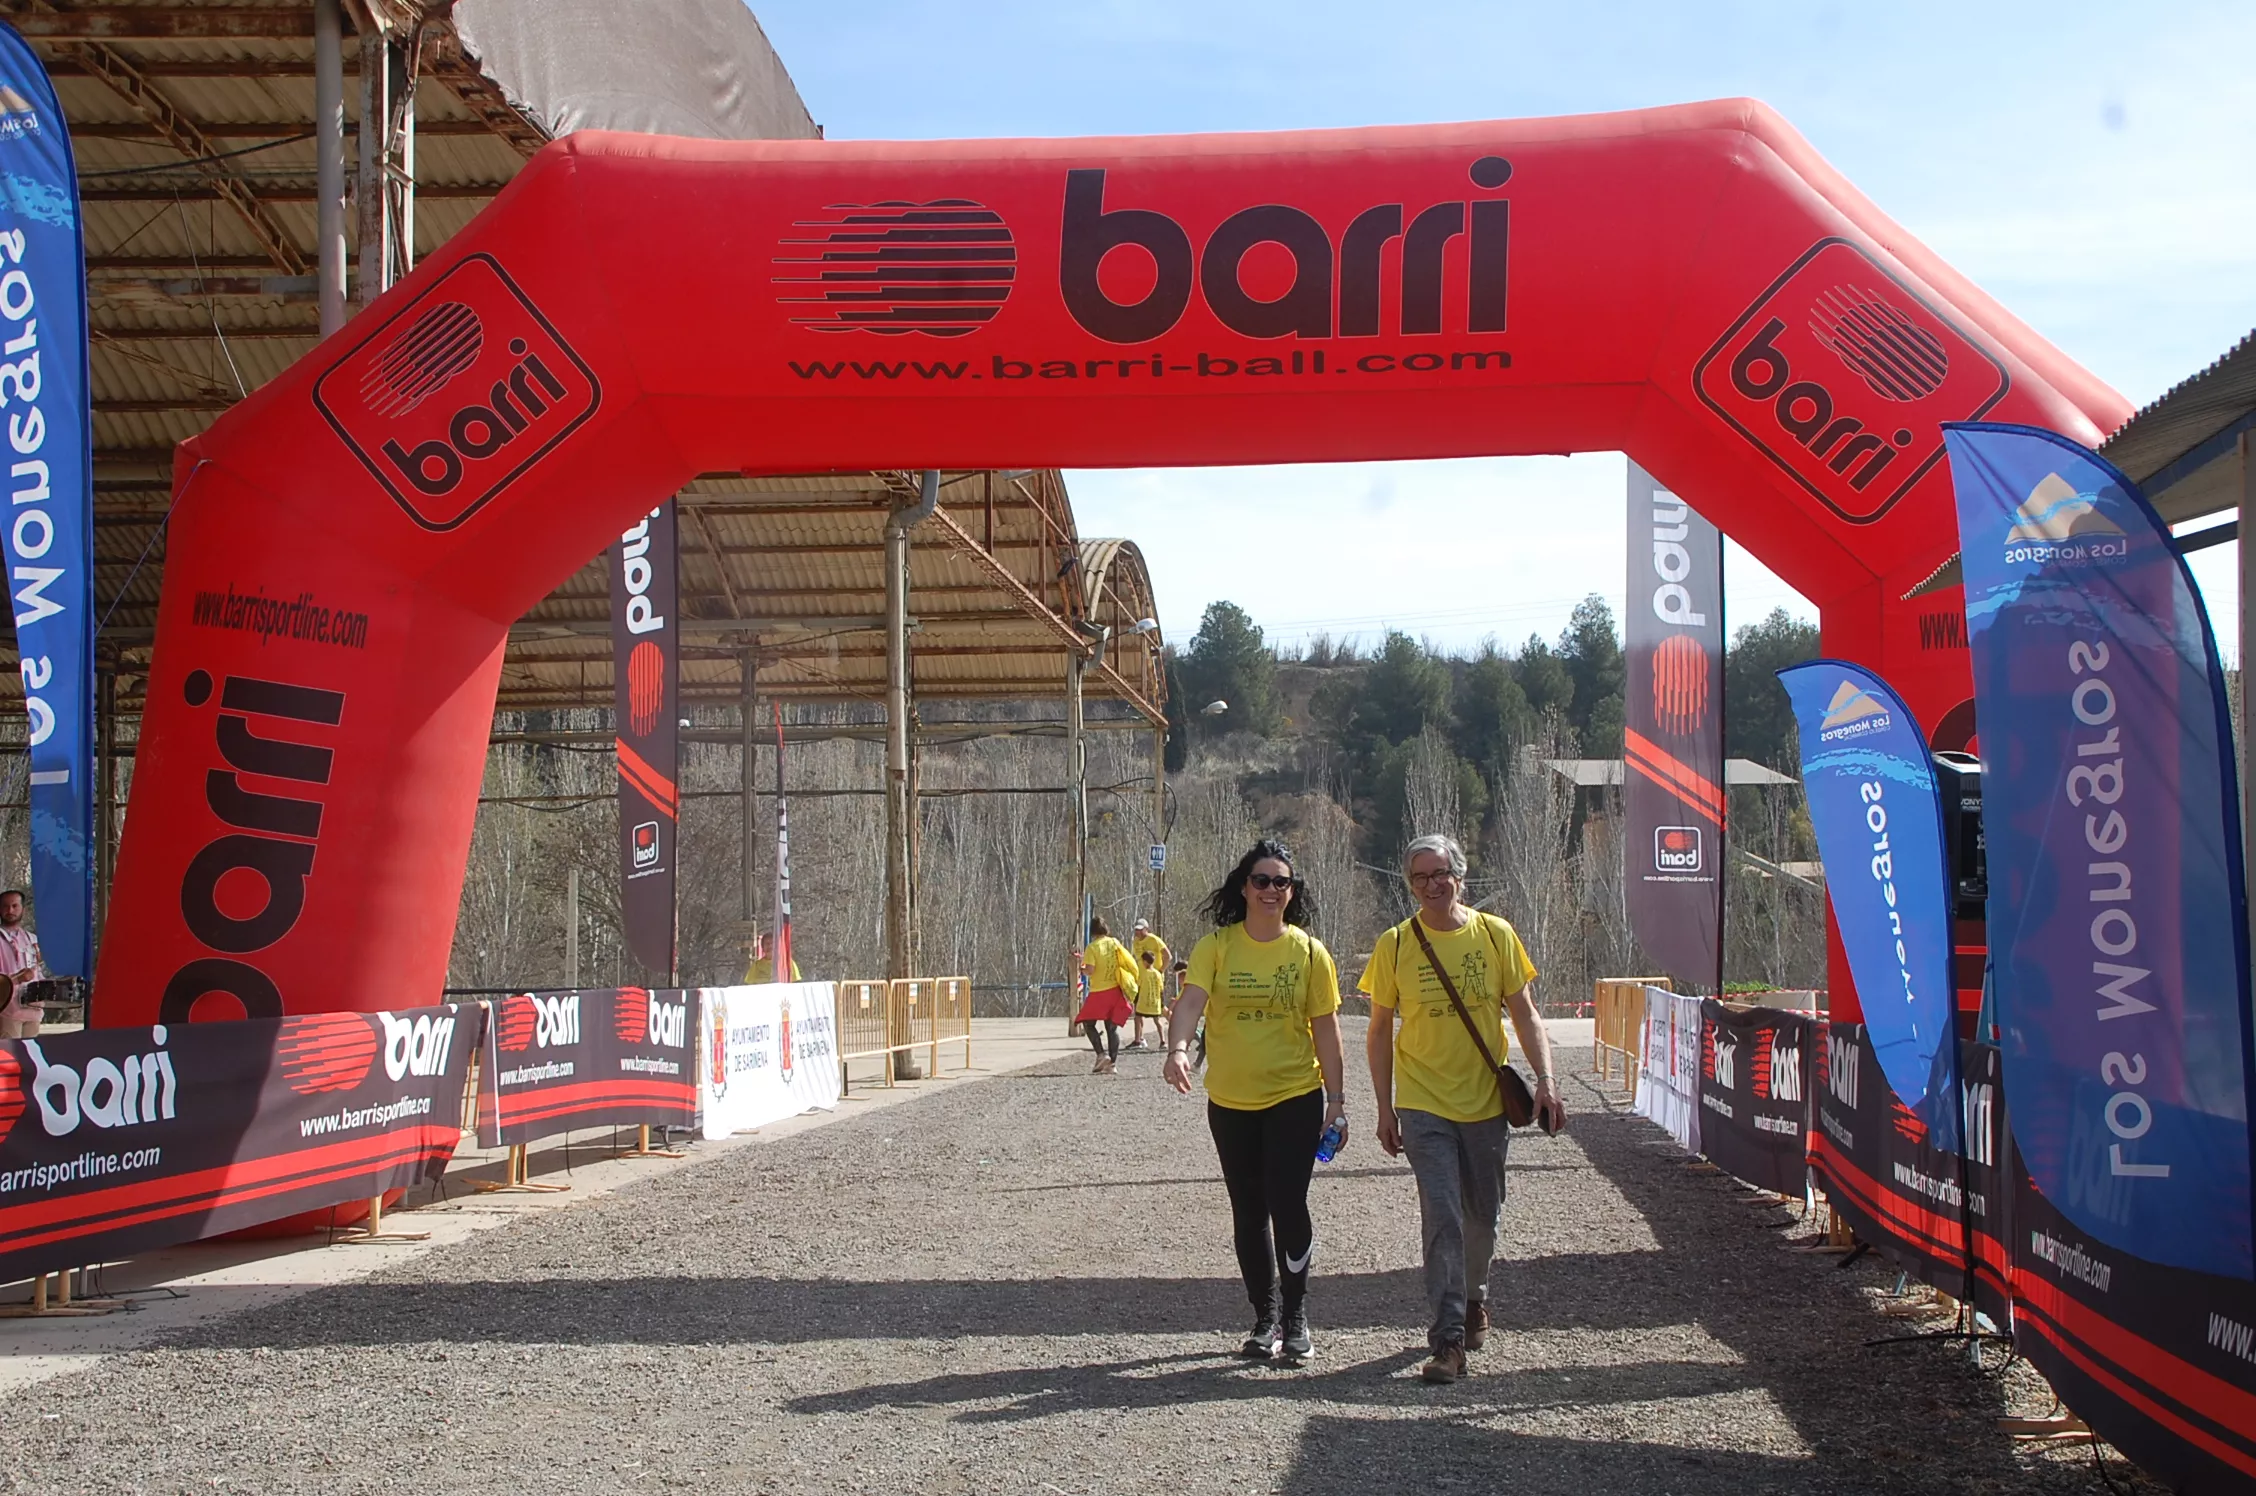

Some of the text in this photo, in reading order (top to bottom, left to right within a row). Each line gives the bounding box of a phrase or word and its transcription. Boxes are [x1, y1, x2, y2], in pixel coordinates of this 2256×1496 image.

[1058, 155, 1514, 345] barri
[788, 349, 1513, 380] www.barri-ball.com
[380, 337, 569, 496] barri
[1729, 316, 1913, 493] barri
[192, 581, 368, 649] www.barrisportline.com
[376, 1003, 459, 1082] barri
[524, 989, 580, 1049] barri
[648, 989, 687, 1049] barri
[732, 1024, 770, 1045] AYUNTAMIENTO
[22, 1024, 177, 1137] barri
[500, 1061, 574, 1086] www.barrisportline.com
[734, 1055, 742, 1073] DE
[1770, 1027, 1801, 1102] barri
